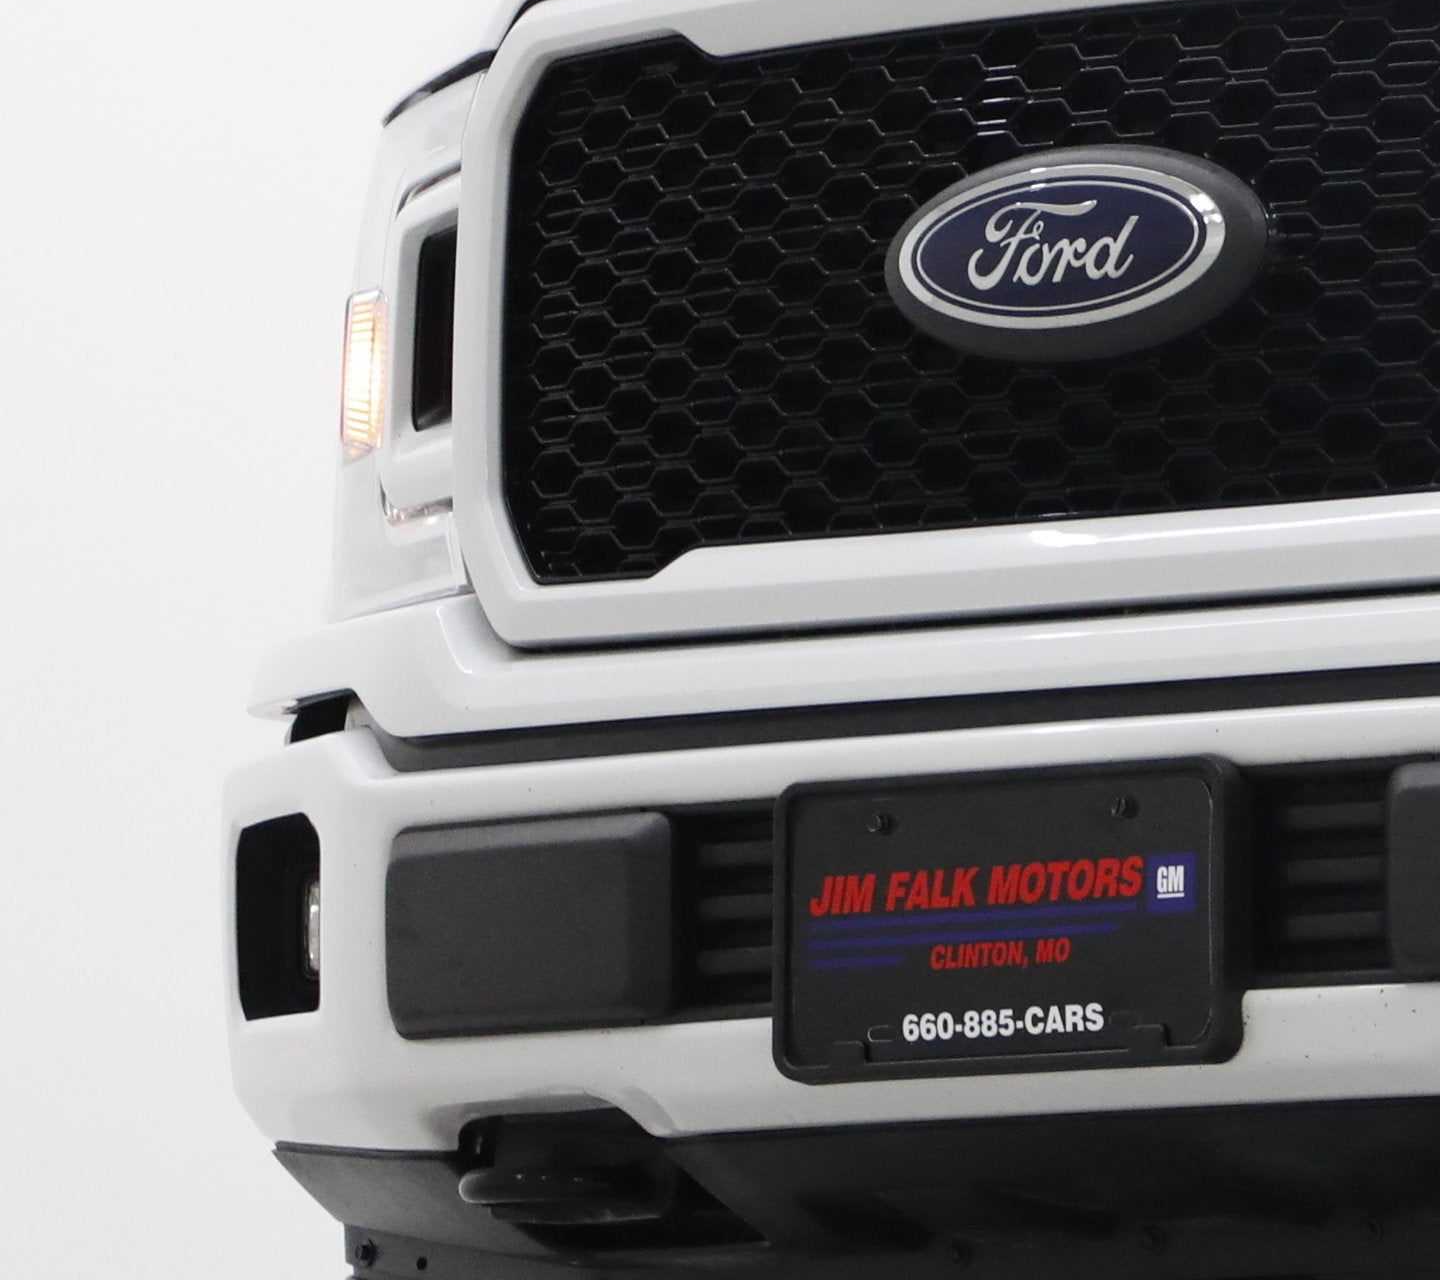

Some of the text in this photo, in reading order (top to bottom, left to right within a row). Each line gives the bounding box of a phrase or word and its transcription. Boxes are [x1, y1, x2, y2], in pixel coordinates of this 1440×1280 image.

[967, 199, 1140, 291] Ford
[808, 854, 1146, 918] JIM FALK MOTORS
[1156, 864, 1185, 899] GM
[929, 937, 1072, 971] CLINTON, MO
[902, 1002, 1105, 1042] 660-885-CARS
